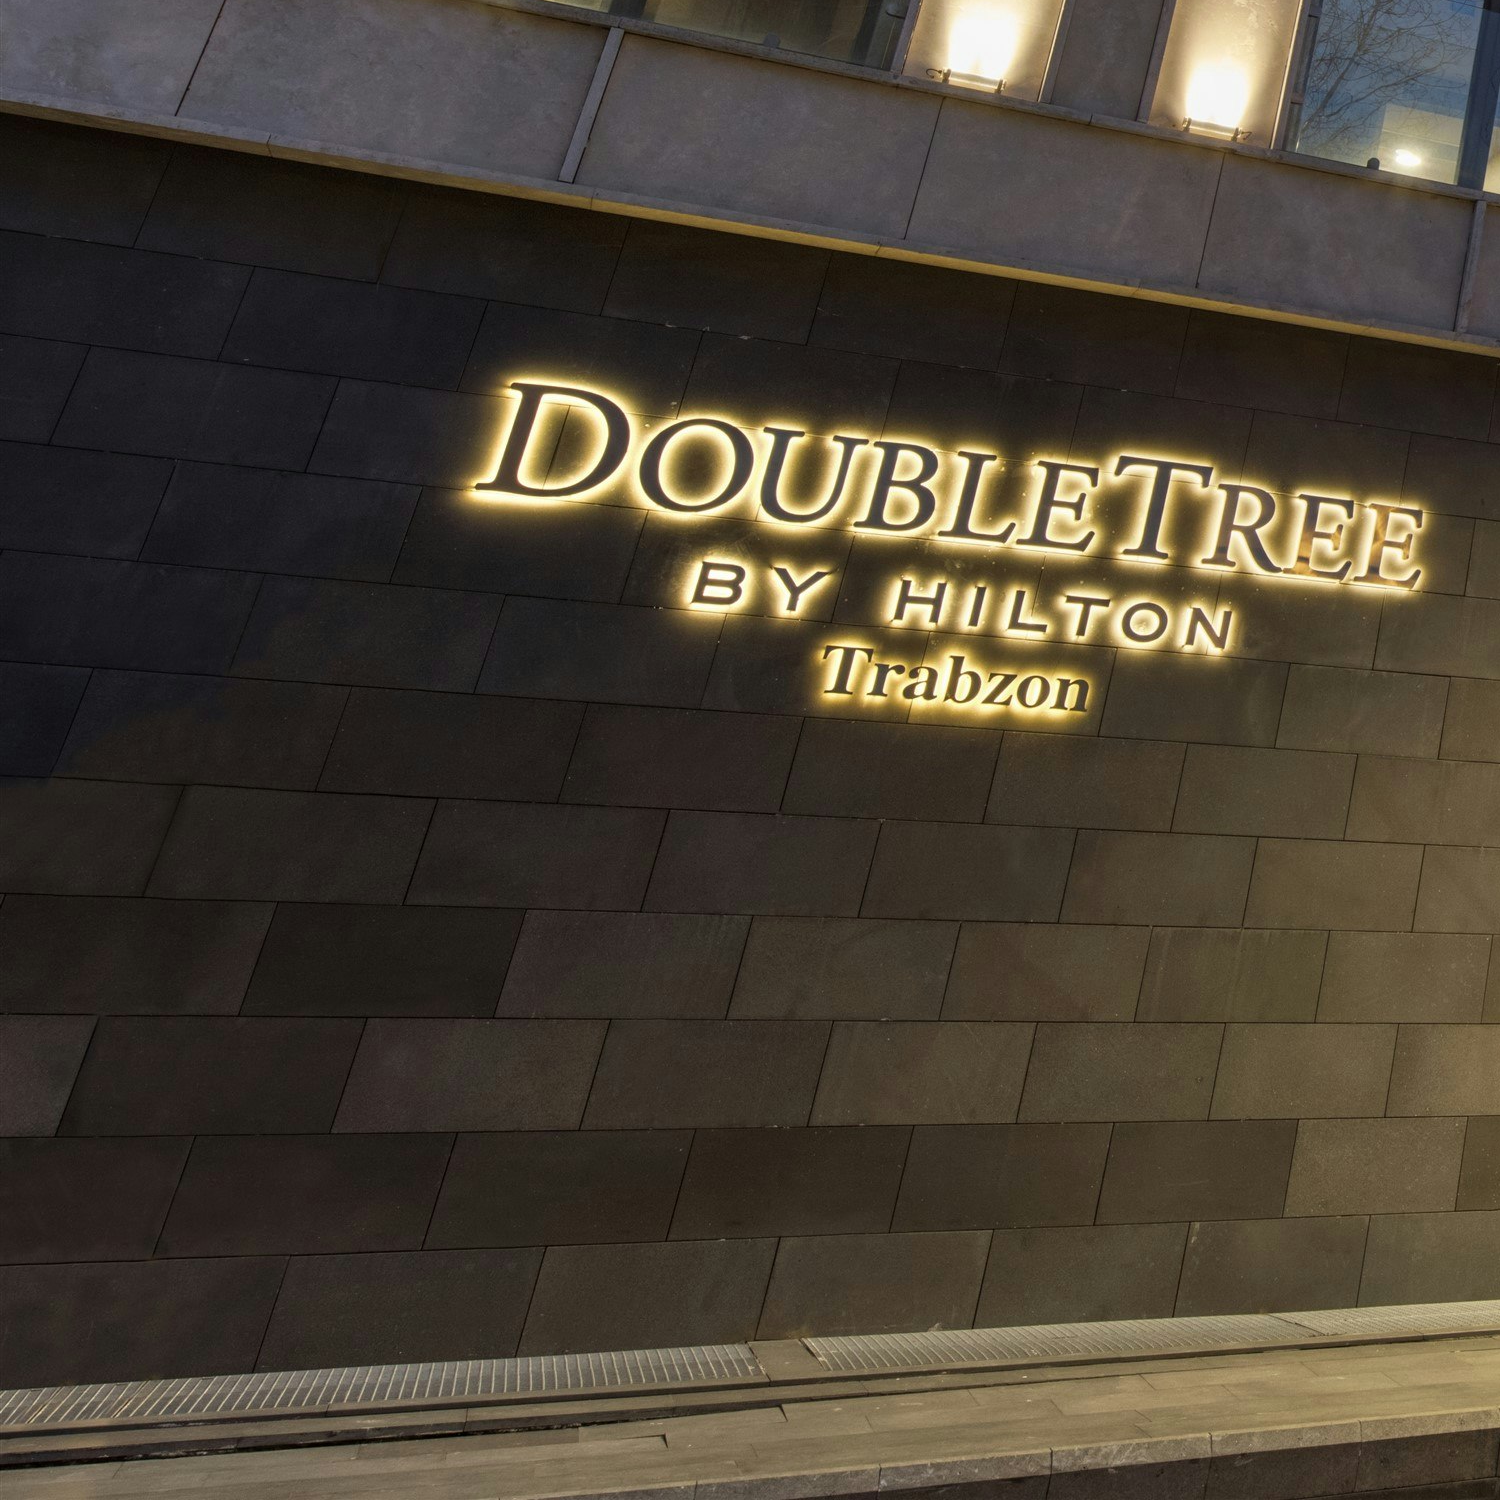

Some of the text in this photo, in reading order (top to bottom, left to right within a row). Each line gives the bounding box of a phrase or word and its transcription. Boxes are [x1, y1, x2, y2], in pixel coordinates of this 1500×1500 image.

[474, 382, 1424, 589] DOUBLETREE
[692, 562, 1233, 650] BY HILTON
[823, 645, 1091, 713] Trabzon
